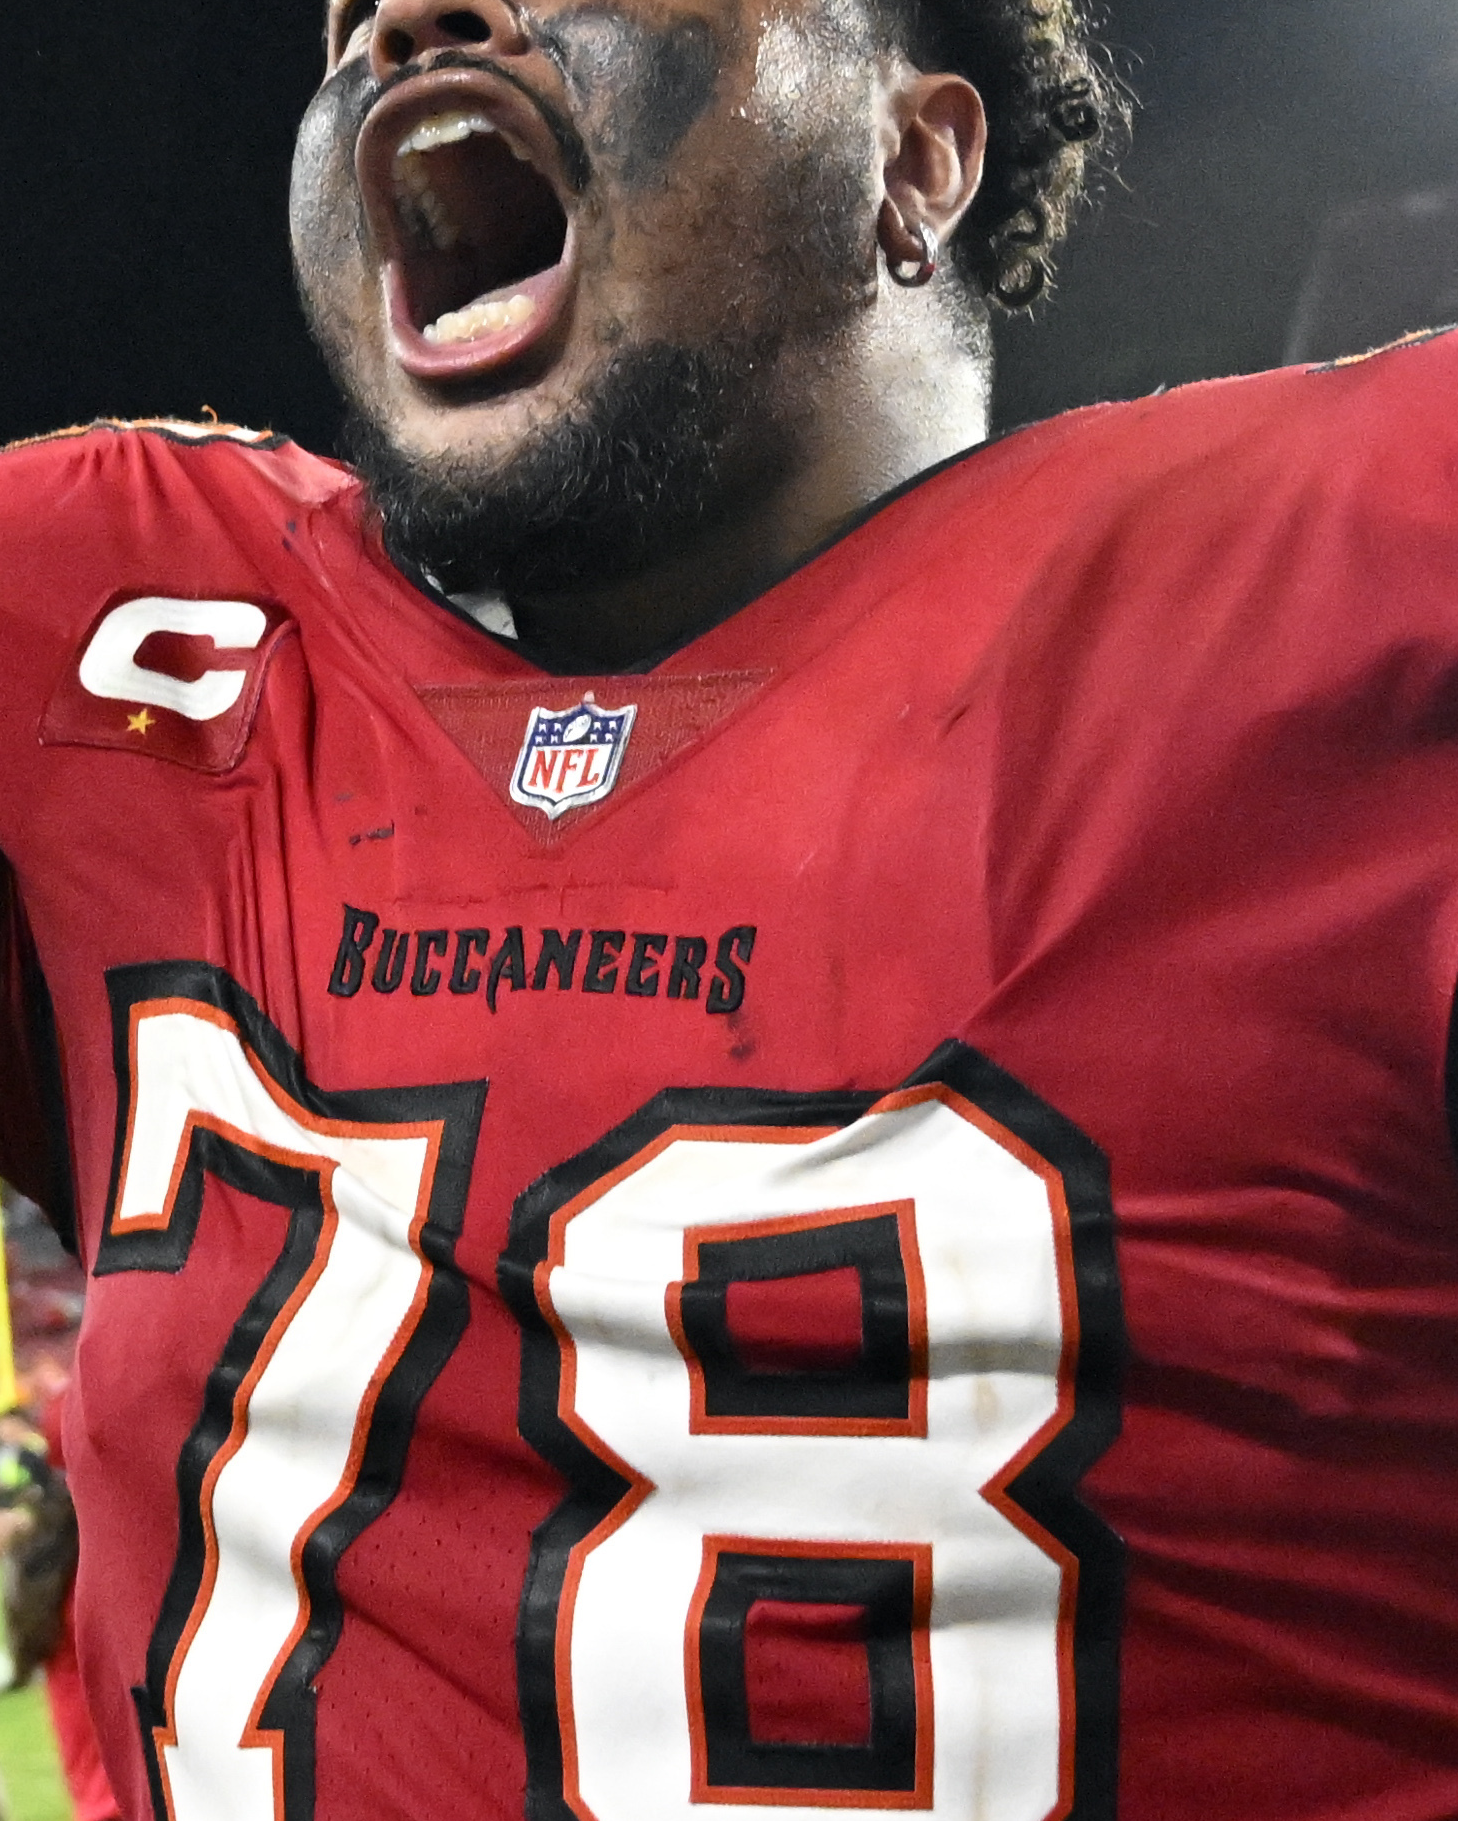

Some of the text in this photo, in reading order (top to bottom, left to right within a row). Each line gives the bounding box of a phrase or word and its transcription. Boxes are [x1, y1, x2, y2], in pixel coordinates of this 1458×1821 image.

[79, 597, 266, 721] C
[527, 747, 603, 794] NFL
[327, 903, 758, 1015] BUCCANEERS
